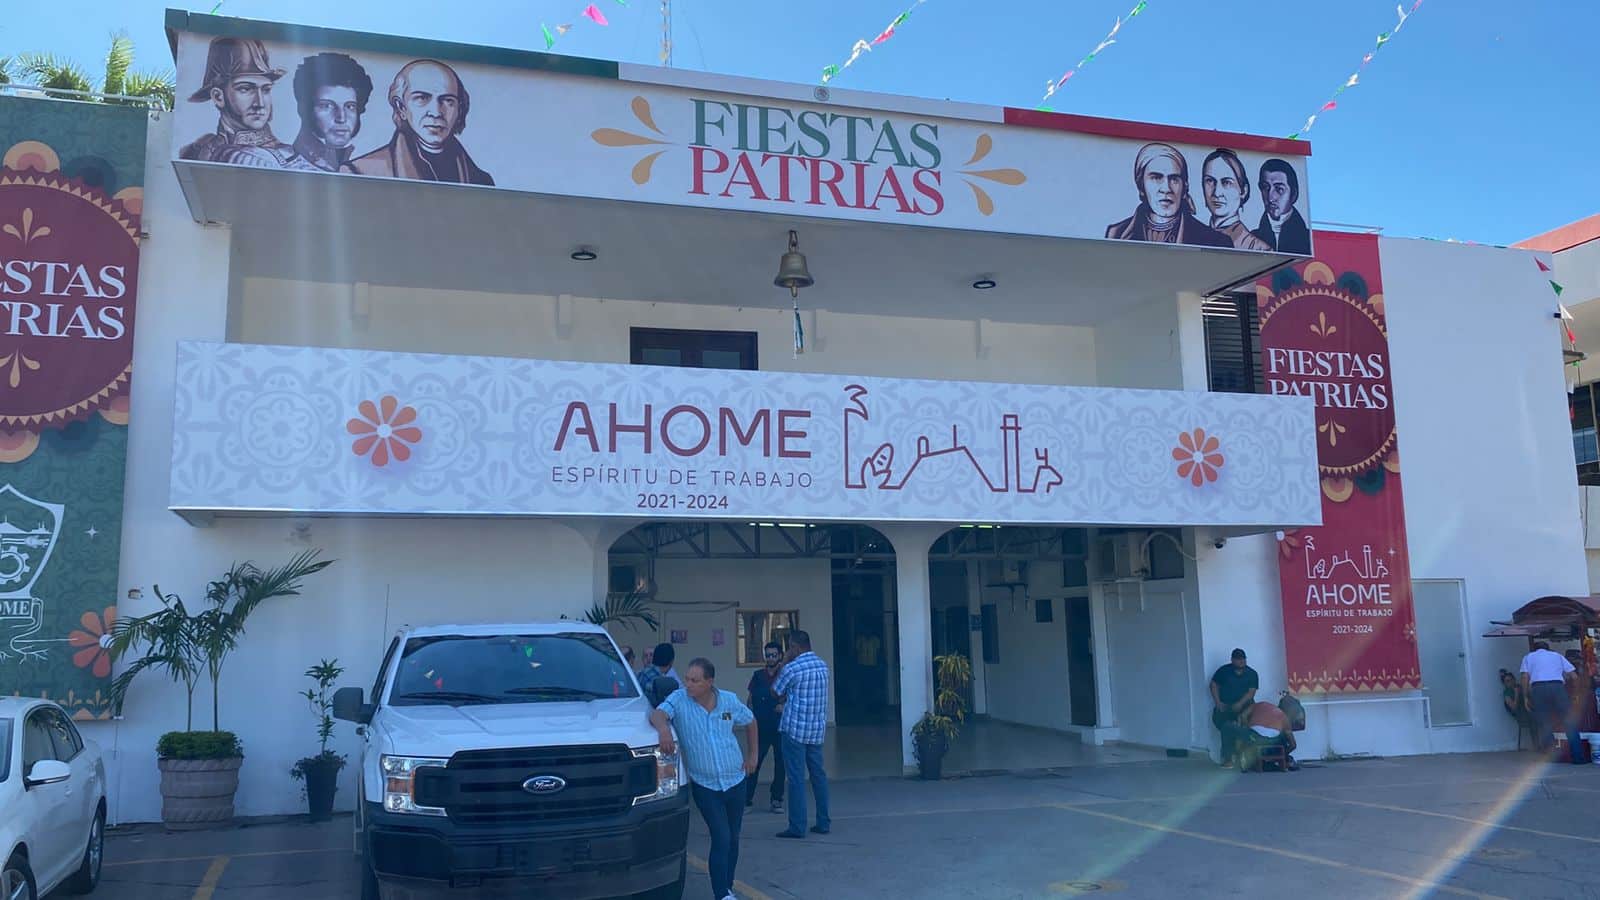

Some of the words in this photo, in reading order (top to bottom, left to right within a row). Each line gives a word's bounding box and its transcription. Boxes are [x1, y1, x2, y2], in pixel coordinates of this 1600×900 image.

[689, 98, 942, 170] FIESTAS
[688, 146, 945, 216] PATRIAS
[0, 260, 126, 298] STAS
[1267, 348, 1384, 379] FIESTAS
[553, 401, 812, 458] AHOME
[552, 464, 658, 485] ESPÍRITU
[669, 469, 697, 486] DE
[711, 470, 813, 488] TRABAJO
[637, 493, 729, 509] 2021-2024
[1305, 584, 1392, 605] AHOME
[0, 600, 30, 616] ME
[1306, 608, 1342, 618] ESPÍRITU
[1343, 609, 1355, 617] DE
[1358, 608, 1392, 617] TRABAJO
[1332, 624, 1373, 634] 2021-2024
